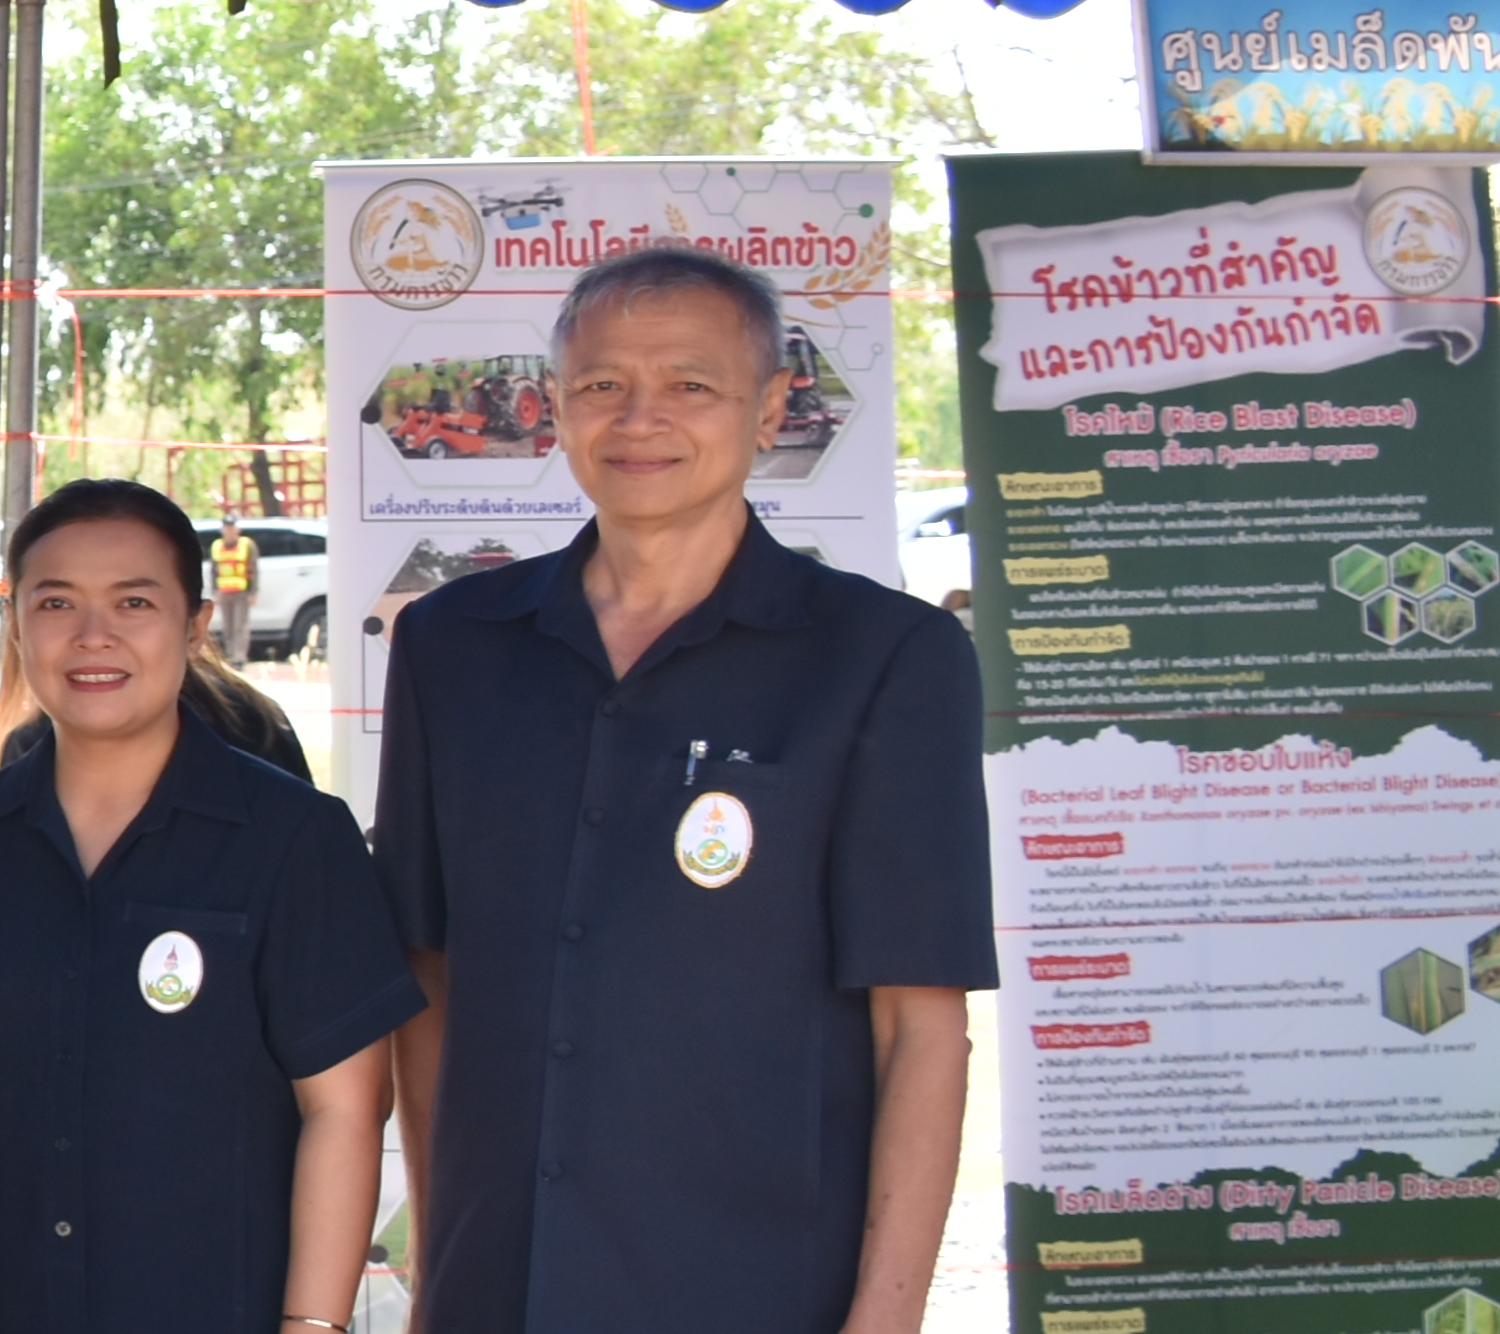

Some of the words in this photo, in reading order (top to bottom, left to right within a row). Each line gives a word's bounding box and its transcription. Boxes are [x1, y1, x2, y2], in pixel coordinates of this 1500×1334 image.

[1032, 227, 1341, 312] โรคข้าวที่สำคัญ
[1020, 294, 1382, 380] และการป้องกันกำจัด
[1306, 399, 1416, 430] Disease)
[1303, 1178, 1394, 1206] Panicle
